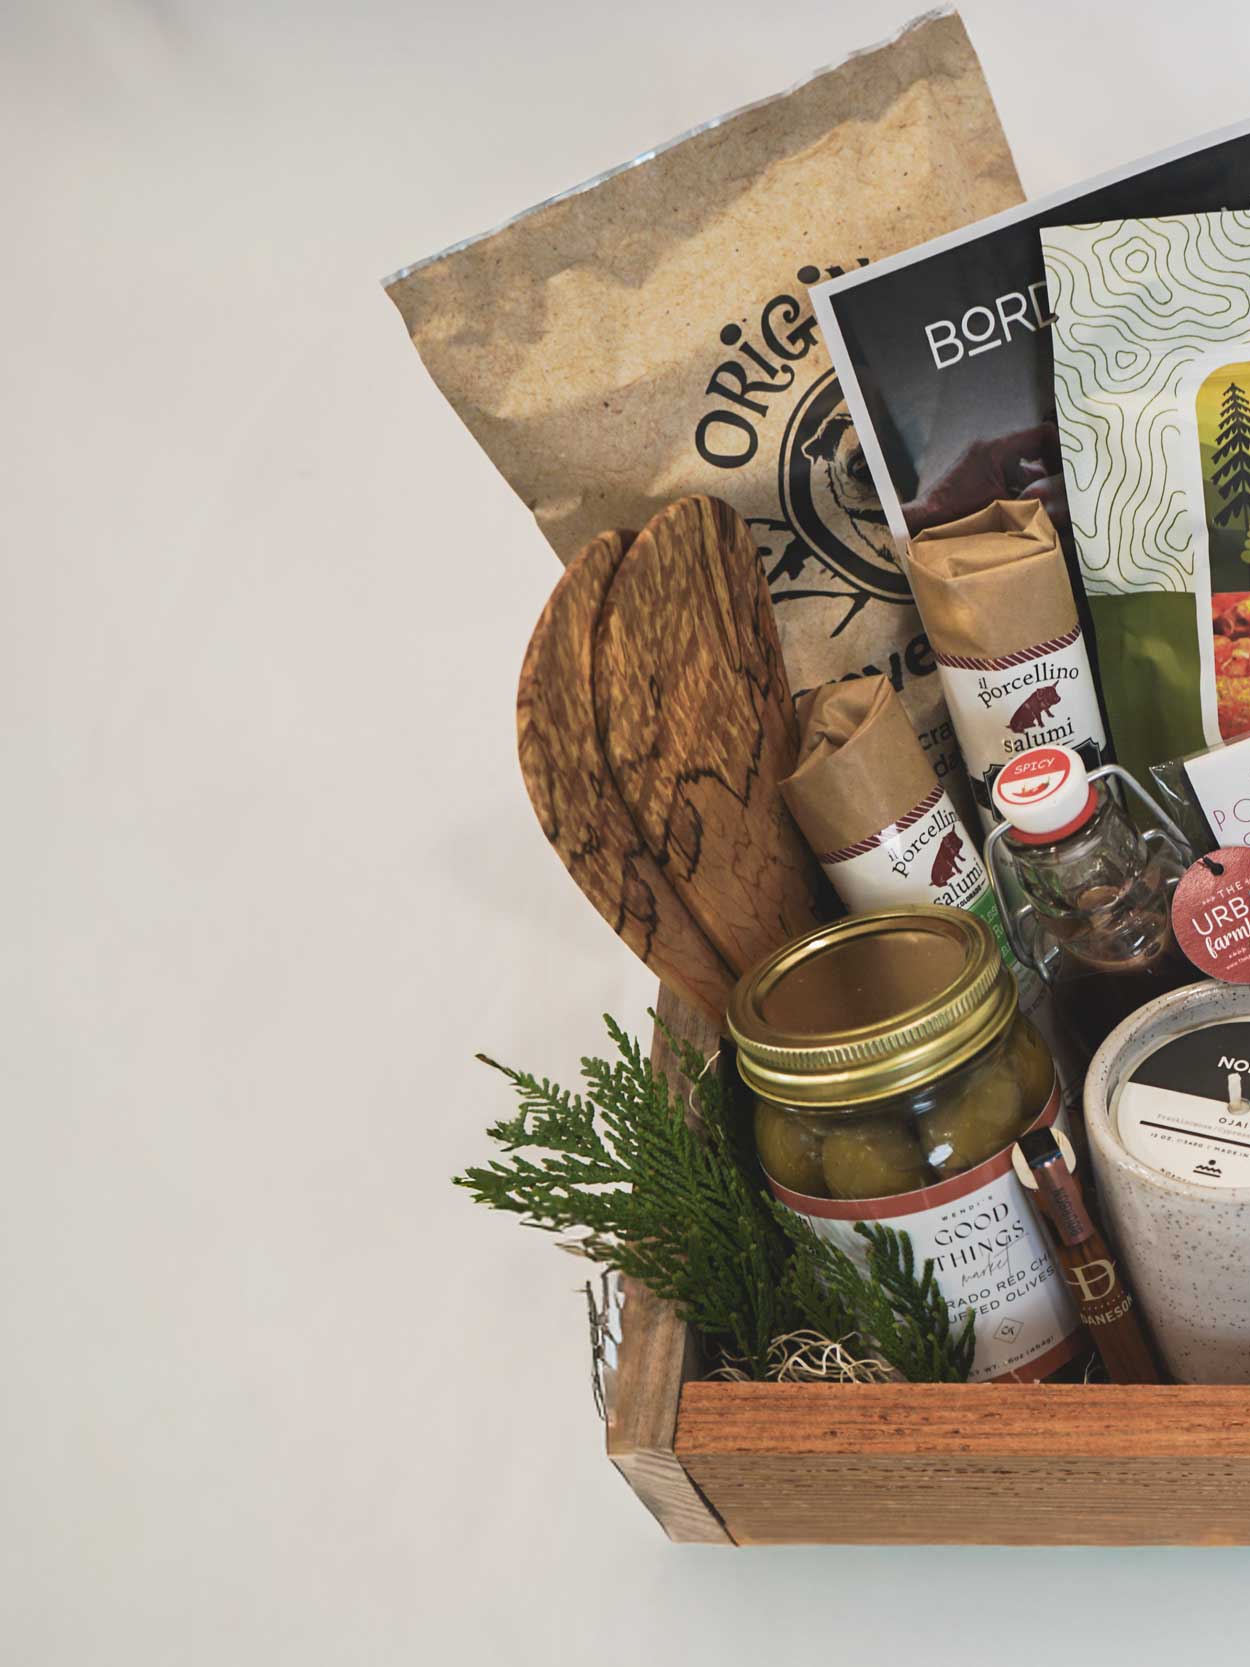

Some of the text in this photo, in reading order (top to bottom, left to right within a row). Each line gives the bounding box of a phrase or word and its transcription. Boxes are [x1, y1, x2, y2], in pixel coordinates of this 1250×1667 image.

[977, 662, 1079, 709] porcellino
[978, 677, 988, 689] il
[1004, 716, 1075, 753] salumi
[1014, 757, 1056, 775] SPICY
[1217, 881, 1243, 898] THE
[1218, 1117, 1249, 1129] OJAI
[935, 1203, 1009, 1246] GOOD
[934, 1220, 1025, 1271] THINGS
[949, 1265, 1055, 1324] UFED OLIVES
[996, 1270, 1026, 1292] RED
